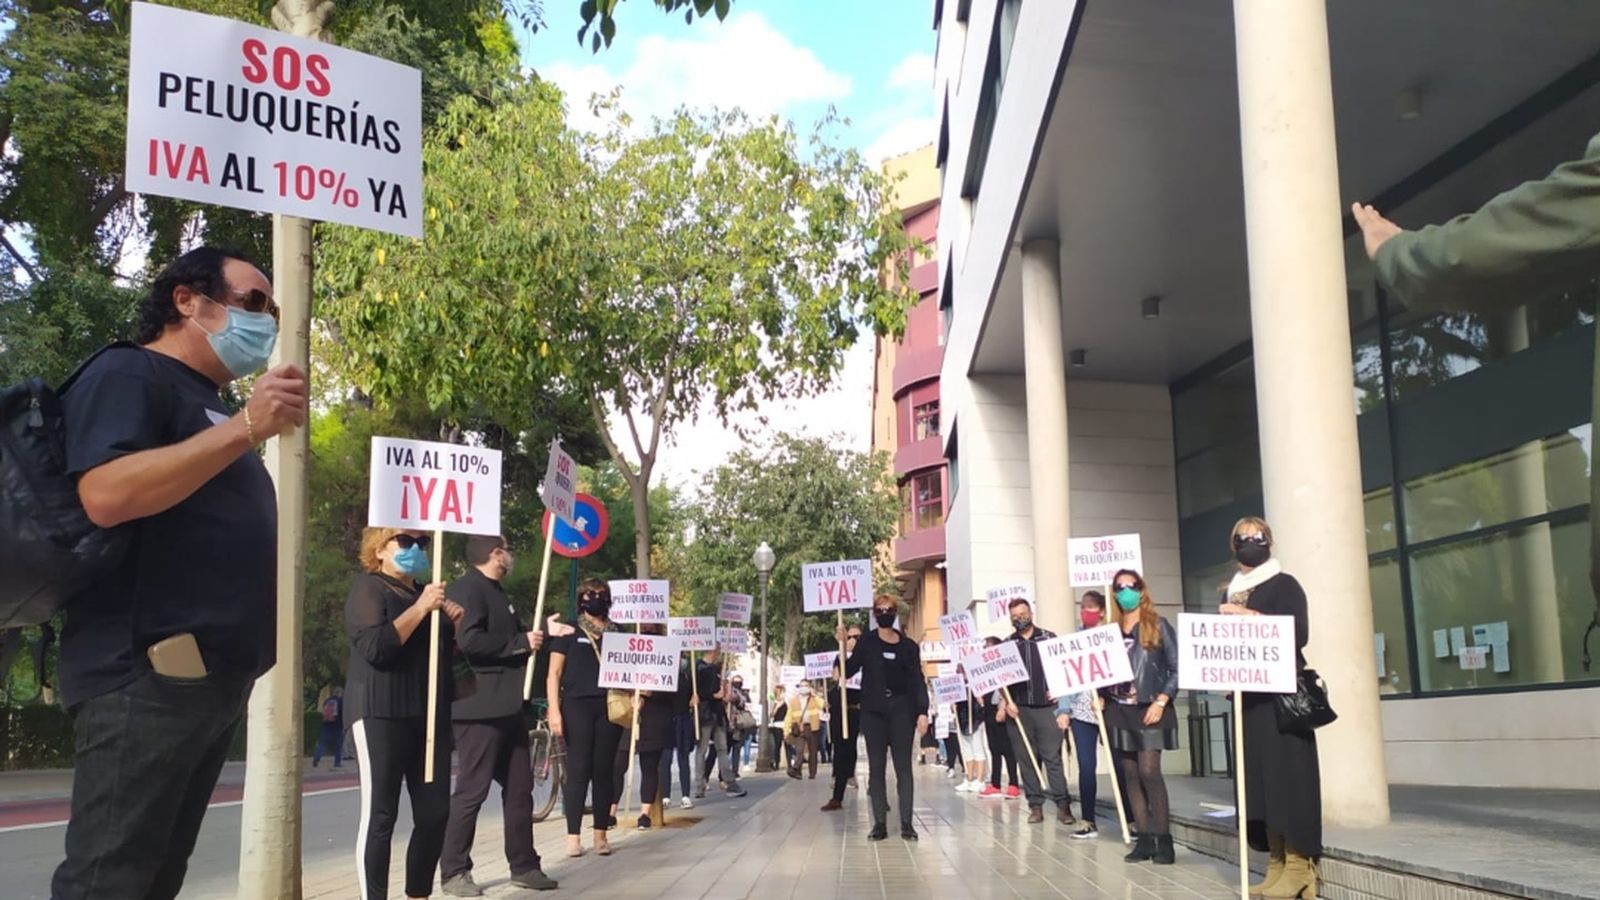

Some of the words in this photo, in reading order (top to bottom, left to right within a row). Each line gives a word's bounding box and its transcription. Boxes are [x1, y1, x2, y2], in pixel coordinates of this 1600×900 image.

[242, 38, 331, 97] SOS
[158, 72, 402, 155] PELUQUERÍAS
[148, 138, 211, 185] IVA
[220, 152, 264, 194] AL
[273, 161, 360, 208] 10%
[368, 177, 408, 219] YA
[386, 446, 416, 468] IVA
[421, 450, 443, 470] AL
[450, 453, 490, 475] 10%
[400, 475, 474, 525] ¡YA!
[1093, 540, 1115, 553] SOS
[809, 567, 823, 578] IVA
[827, 566, 838, 577] AL
[841, 564, 865, 576] 10%
[1074, 572, 1089, 582] IVA
[1091, 571, 1101, 582] AL
[1103, 570, 1116, 581] 10
[628, 582, 648, 594] SOS
[818, 579, 857, 606] ¡YA!
[611, 610, 623, 619] IVA
[624, 609, 634, 619] AL
[655, 610, 665, 619] YA
[684, 619, 699, 628] SOS
[948, 623, 970, 641] ¡YA!
[1191, 621, 1208, 639] LA
[1212, 619, 1280, 640] ESTÉTICA
[628, 637, 654, 652] SOS
[1047, 639, 1067, 657] IVA
[1070, 637, 1083, 652] AL
[1086, 631, 1115, 649] 10%
[1192, 640, 1257, 661] TAMBIÉN
[1262, 646, 1280, 662] ES
[607, 652, 673, 667] PELUQUERÍAS
[982, 649, 1002, 663] SOS
[1062, 650, 1114, 688] ¡YA!
[1201, 667, 1271, 685] ESENCIAL
[604, 671, 619, 682] IVA
[621, 672, 632, 683] AL
[635, 673, 659, 685] 10%
[661, 674, 673, 686] YA
[975, 681, 988, 692] IVA
[988, 678, 998, 687] AL
[1016, 668, 1025, 677] YA
